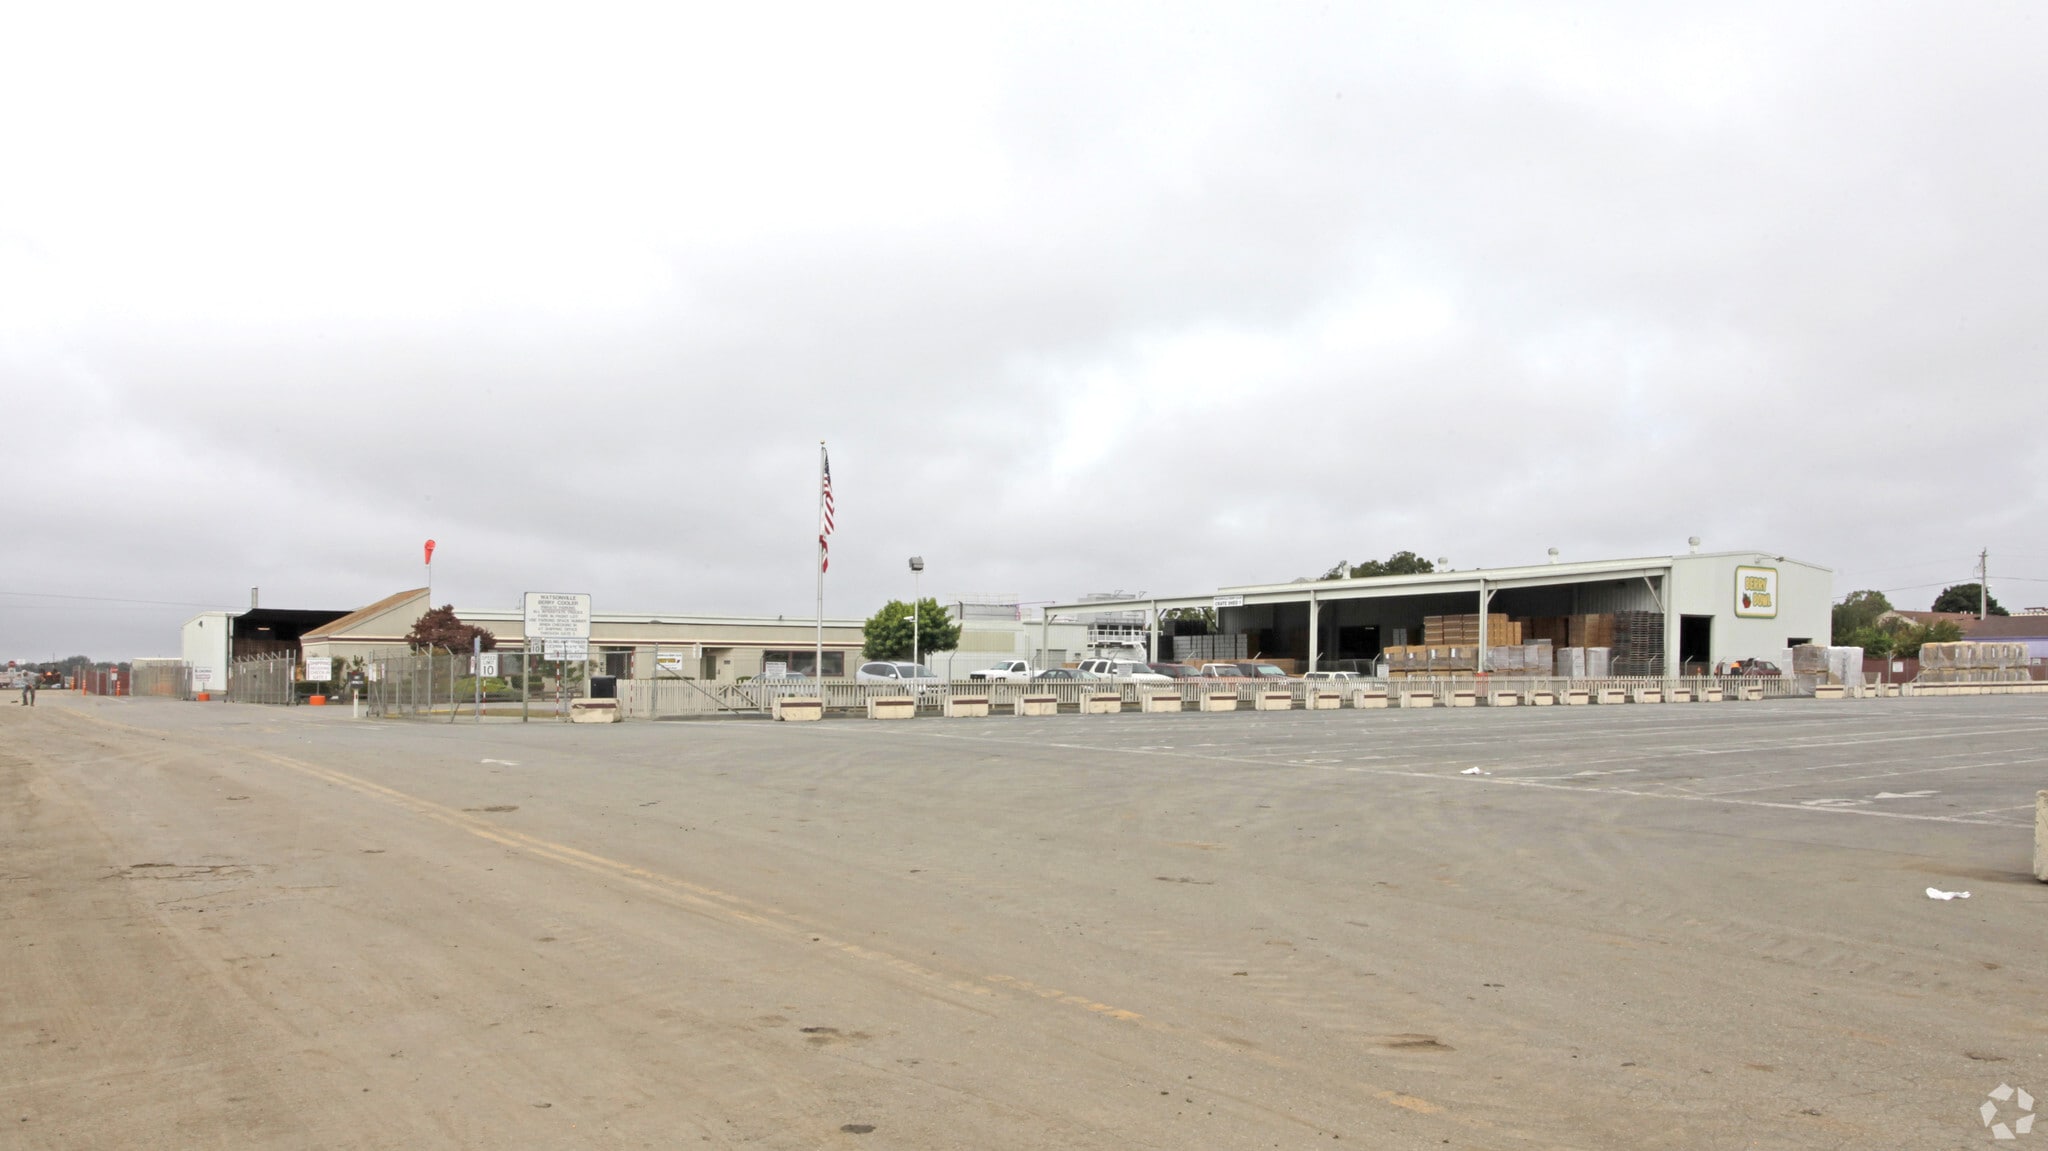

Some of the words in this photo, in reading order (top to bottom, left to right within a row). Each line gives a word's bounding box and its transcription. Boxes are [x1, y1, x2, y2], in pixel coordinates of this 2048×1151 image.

[1745, 576, 1767, 592] BERRY
[1752, 592, 1772, 607] BOWL
[483, 665, 494, 675] 10
